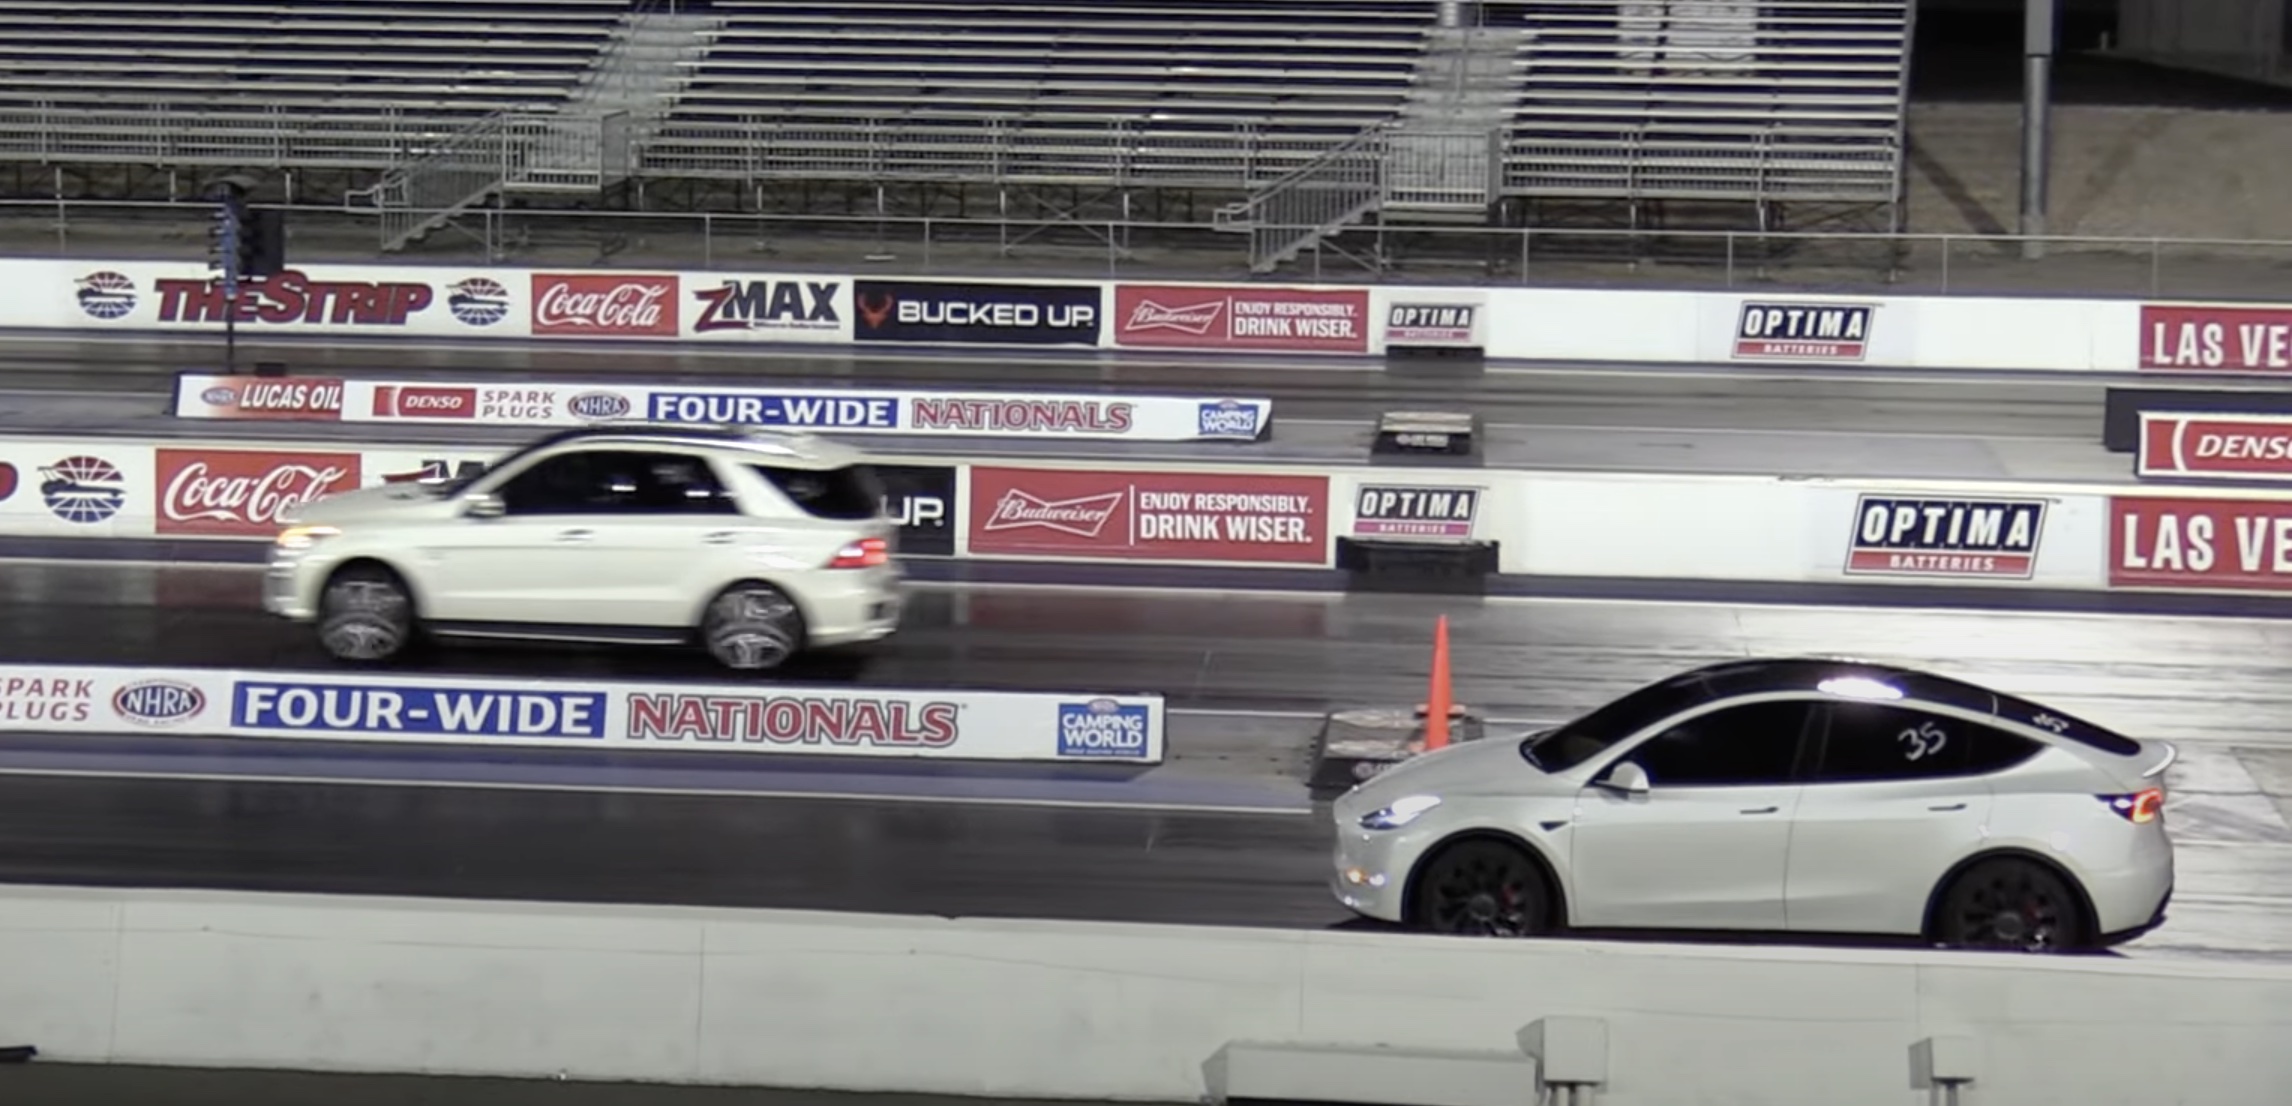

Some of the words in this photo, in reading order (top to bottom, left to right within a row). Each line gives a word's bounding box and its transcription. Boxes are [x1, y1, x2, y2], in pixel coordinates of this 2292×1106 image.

[537, 282, 669, 326] Coca-Cola
[898, 302, 1039, 327] BUCKED
[1235, 302, 1270, 315] ENJOY
[1235, 317, 1291, 336] DRINK
[1295, 318, 1358, 338] WISER.
[1391, 307, 1470, 326] OPTIMA
[1744, 308, 1864, 339] OPTIMA
[1763, 344, 1838, 356] BATTERIES
[2154, 322, 2223, 367] LAS
[240, 384, 306, 409] LUCAS
[309, 385, 341, 410] OIL
[405, 395, 463, 409] DENSO
[483, 390, 555, 404] SPARK
[577, 396, 622, 415] NHRA
[482, 405, 553, 419] PLUGS
[655, 396, 890, 426] FOUR-WIDE
[911, 398, 1133, 432] NATIONALS
[1202, 419, 1254, 431] WORLD
[997, 498, 1106, 522] Budweiser
[1140, 491, 1192, 511] ENJOY
[1195, 493, 1313, 515] RESPONSIBLY.
[1361, 490, 1470, 518] OPTIMA
[1140, 515, 1219, 540] DRINK
[1226, 516, 1312, 543] WISER.
[1861, 505, 2030, 548] OPTIMA
[2123, 513, 2214, 572] LAS
[1890, 555, 1994, 572] BATTERIES
[0, 677, 94, 699] PARK
[0, 700, 90, 721] LUGS
[126, 686, 192, 716] NHRA
[245, 686, 593, 735] FOUR-WIDE
[626, 692, 959, 747] NATIONALS
[1062, 713, 1143, 731] CAMPING
[1063, 729, 1143, 748] WORLD
[1898, 720, 1947, 761] 35
